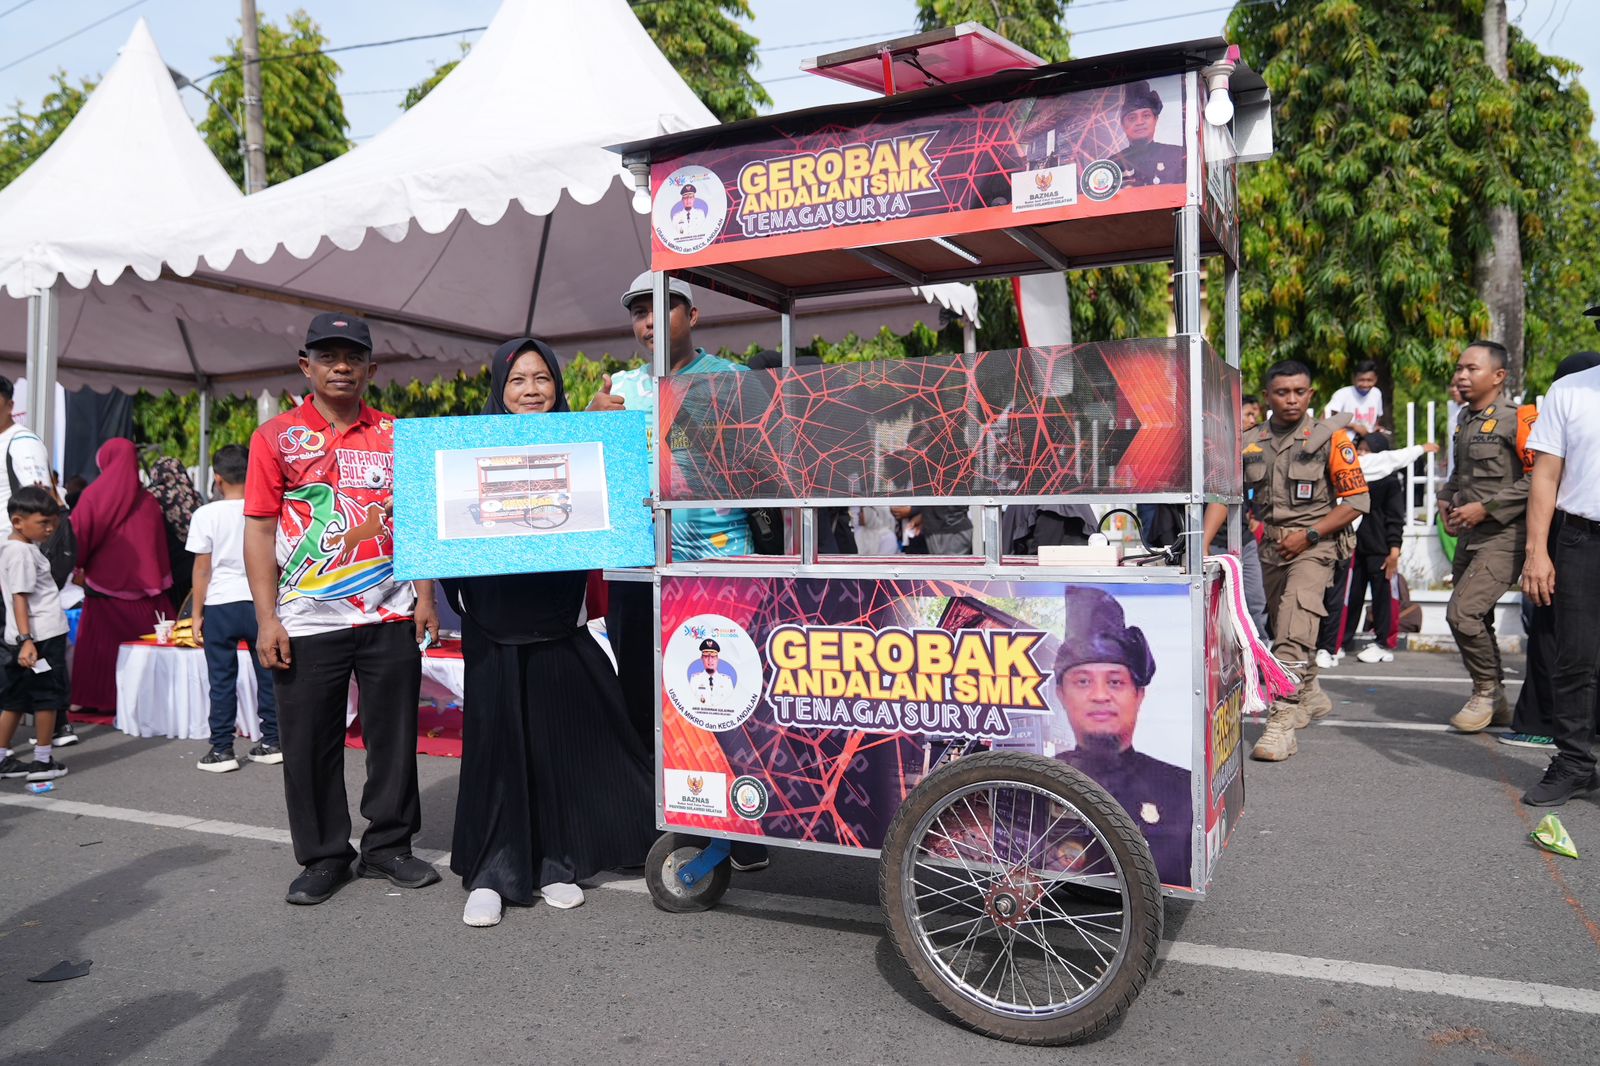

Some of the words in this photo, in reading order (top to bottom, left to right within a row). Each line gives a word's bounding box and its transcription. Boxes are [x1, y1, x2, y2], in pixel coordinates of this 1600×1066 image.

[741, 136, 932, 194] GEROBAK
[743, 177, 864, 215] ANDALAN
[870, 166, 933, 197] SMK
[1029, 190, 1059, 200] BAZNAS
[743, 206, 831, 233] TENAGA
[835, 195, 906, 220] SURYA
[342, 465, 367, 480] SULS
[770, 629, 1042, 678] GEROBAK
[773, 670, 943, 702] ANDALAN
[954, 675, 1043, 707] SMK
[668, 688, 685, 713] USAHA
[683, 710, 705, 727] MIKRO
[717, 718, 737, 729] KECIL
[736, 693, 759, 723] ANDALAN
[775, 697, 898, 726] TENAGA
[905, 703, 1007, 731] SURYA
[682, 795, 710, 804] BAZNAS
